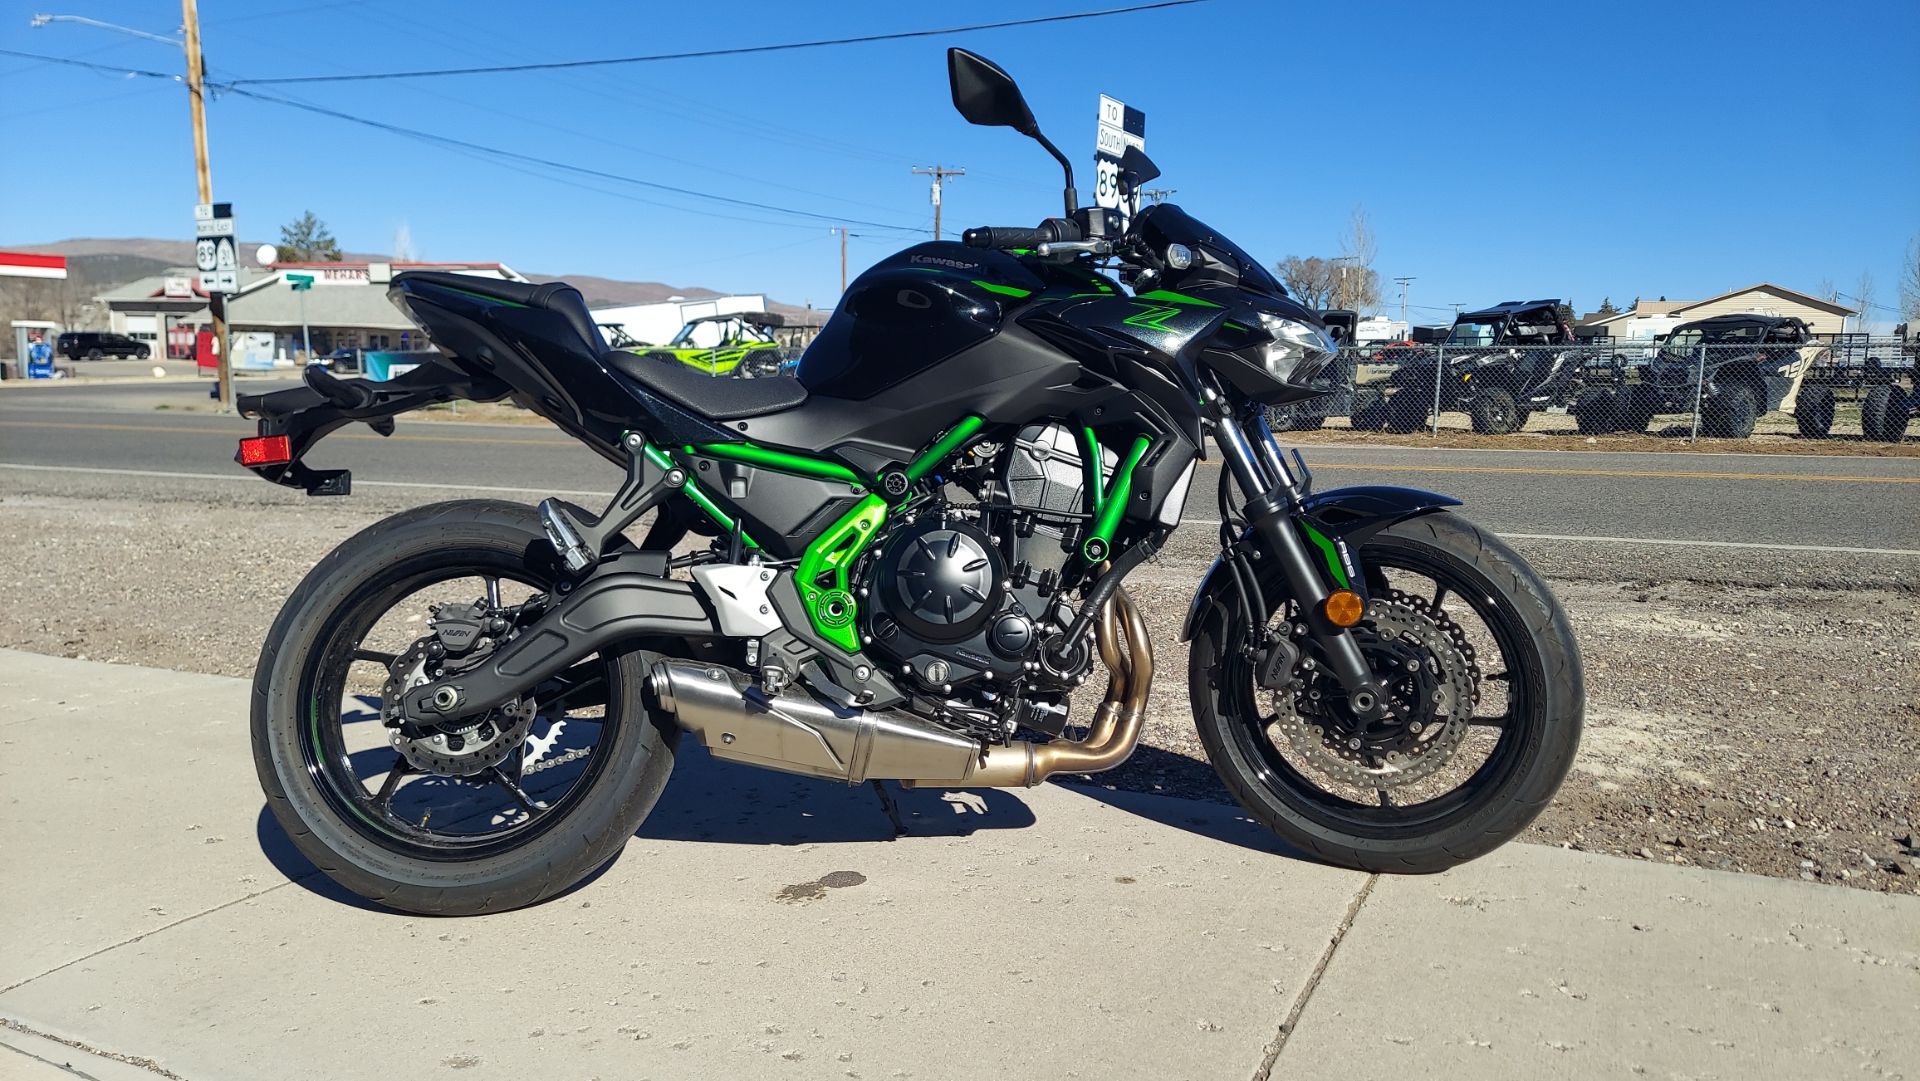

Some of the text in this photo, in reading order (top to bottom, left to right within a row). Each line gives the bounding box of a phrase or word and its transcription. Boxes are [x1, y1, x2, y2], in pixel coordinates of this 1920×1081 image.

[1107, 104, 1118, 121] TO
[1100, 128, 1121, 151] SOUTH
[1100, 169, 1117, 199] 89
[199, 246, 214, 262] 89
[1338, 541, 1356, 578] ABS
[441, 629, 472, 637] NISSIN
[1271, 651, 1286, 681] NISSIN
